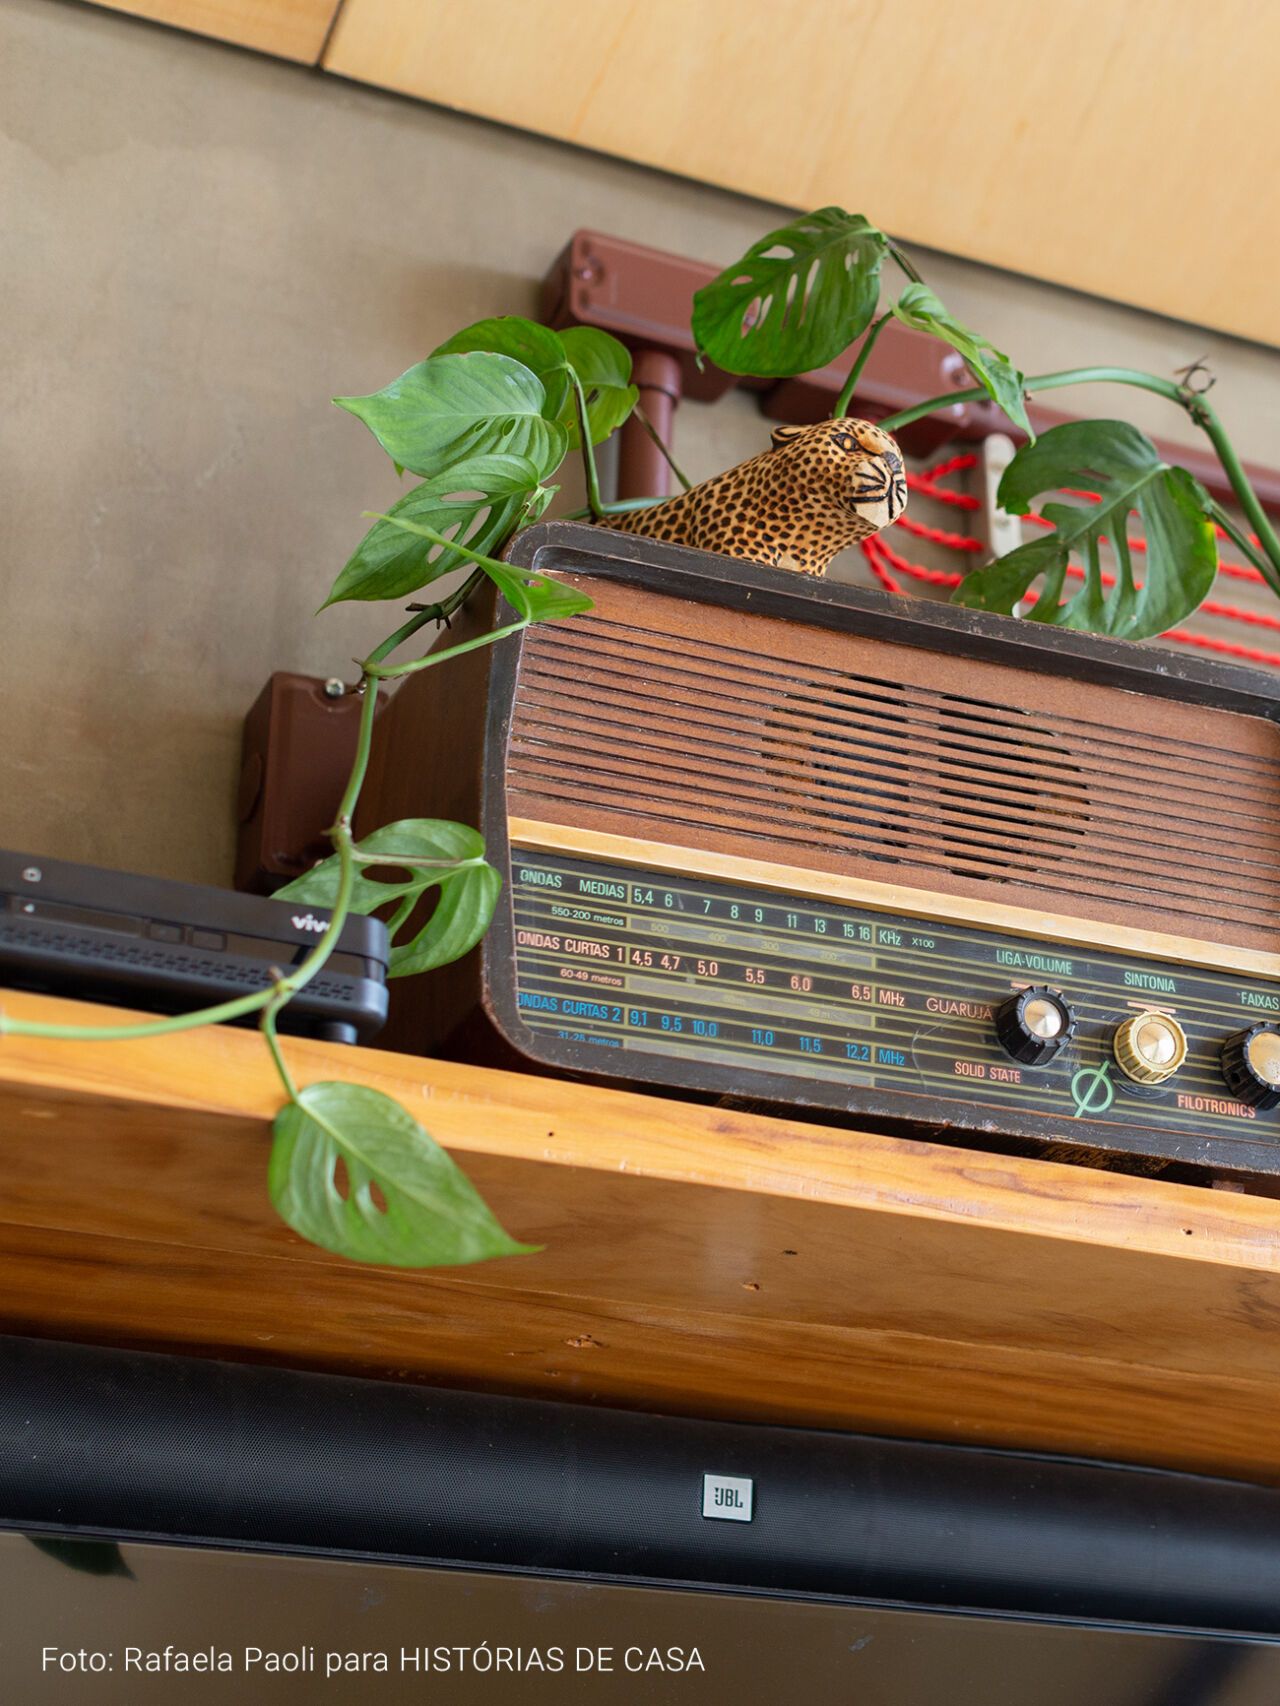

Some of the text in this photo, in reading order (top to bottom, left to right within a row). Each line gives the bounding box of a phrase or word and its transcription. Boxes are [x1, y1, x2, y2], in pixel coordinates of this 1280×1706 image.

[520, 869, 625, 898] ONDAS MEDIAS
[291, 913, 331, 933] viv
[551, 906, 624, 926] 550-200 metros
[634, 888, 653, 904] 5,4
[664, 893, 673, 907] 6
[704, 900, 711, 914] 7
[730, 905, 739, 919] 8
[755, 908, 763, 923] 9
[787, 914, 798, 928] 11
[814, 918, 826, 933] 13
[843, 923, 855, 938] 15
[858, 926, 871, 940] 16
[879, 930, 901, 946] KHz
[517, 931, 623, 961] ONDAS CURTAS 1
[996, 950, 1072, 975] LIGA-VOLUME
[560, 968, 622, 986] 60-49 metros
[632, 950, 905, 1007] 4,5 4,7 5,0 5,5 6,0 6,5 MHz
[1124, 971, 1176, 993] SINTONIA
[517, 992, 621, 1021] ONDAS CURTAS 2
[926, 997, 993, 1020] GUARUJÁ
[1241, 991, 1279, 1010] FAIXAS
[630, 1010, 905, 1066] 9,1 9,5 10,0 11,0 11,5 12,2 MHz
[954, 1061, 1021, 1083] SOLID STATE
[1176, 1094, 1256, 1118] FILOTRONICS
[714, 1487, 743, 1508] JBL
